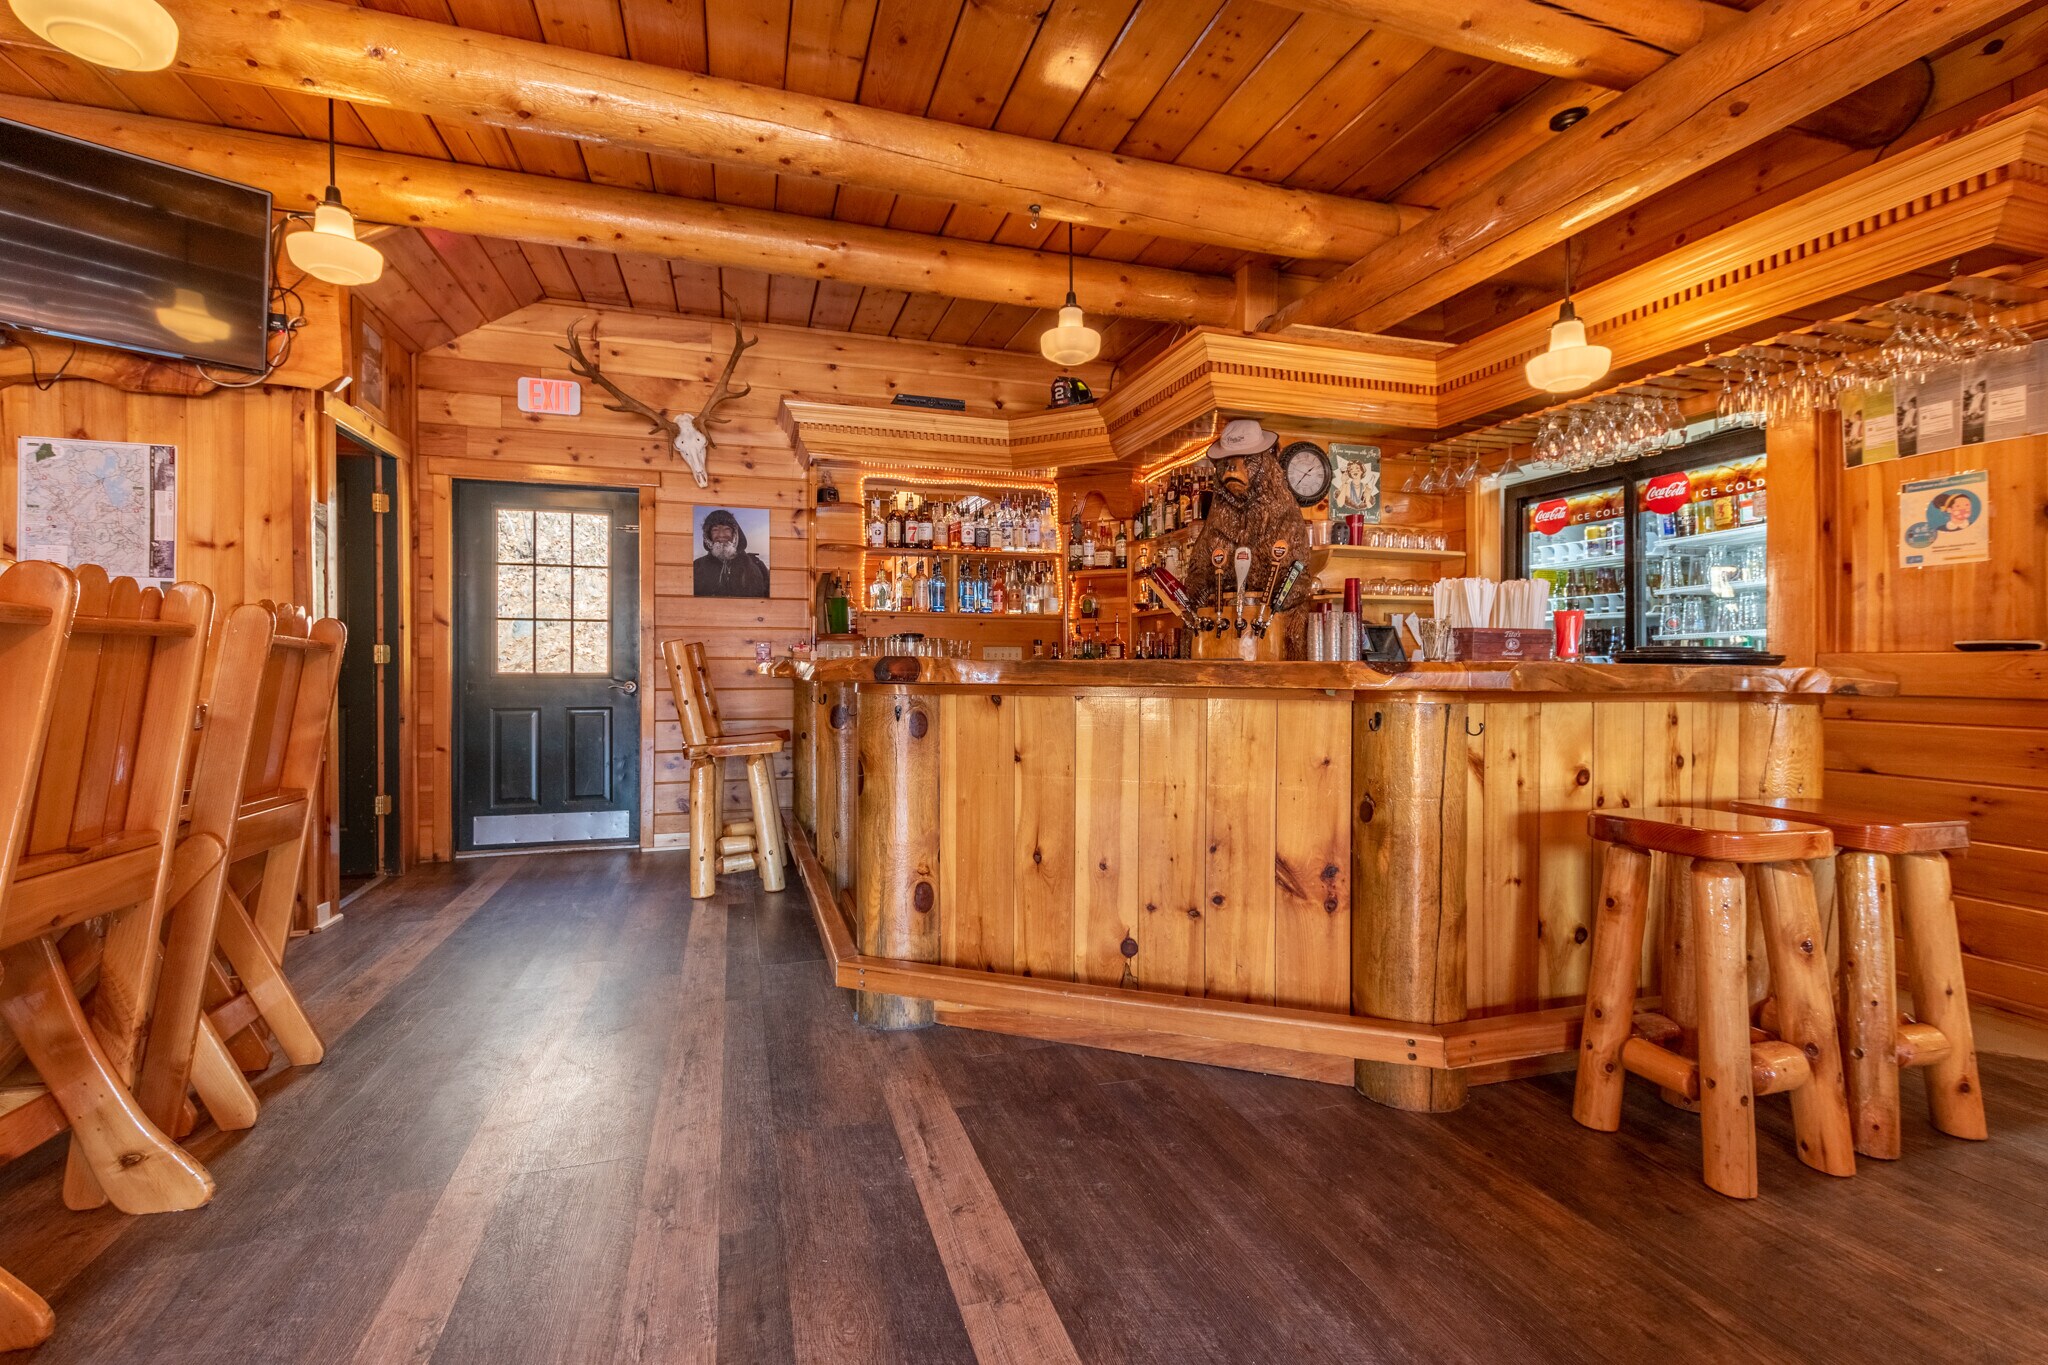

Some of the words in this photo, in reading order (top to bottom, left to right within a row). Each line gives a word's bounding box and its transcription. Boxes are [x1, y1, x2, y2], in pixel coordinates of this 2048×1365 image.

[528, 379, 573, 411] EXIT
[1055, 387, 1064, 399] 2
[1646, 480, 1688, 501] Coca-Cola
[1695, 487, 1718, 498] ICE
[1725, 478, 1766, 493] COLD
[1535, 506, 1567, 523] Coca-Cola
[1573, 512, 1590, 522] ICE
[907, 526, 918, 542] 7
[1504, 630, 1521, 638] Tito's
